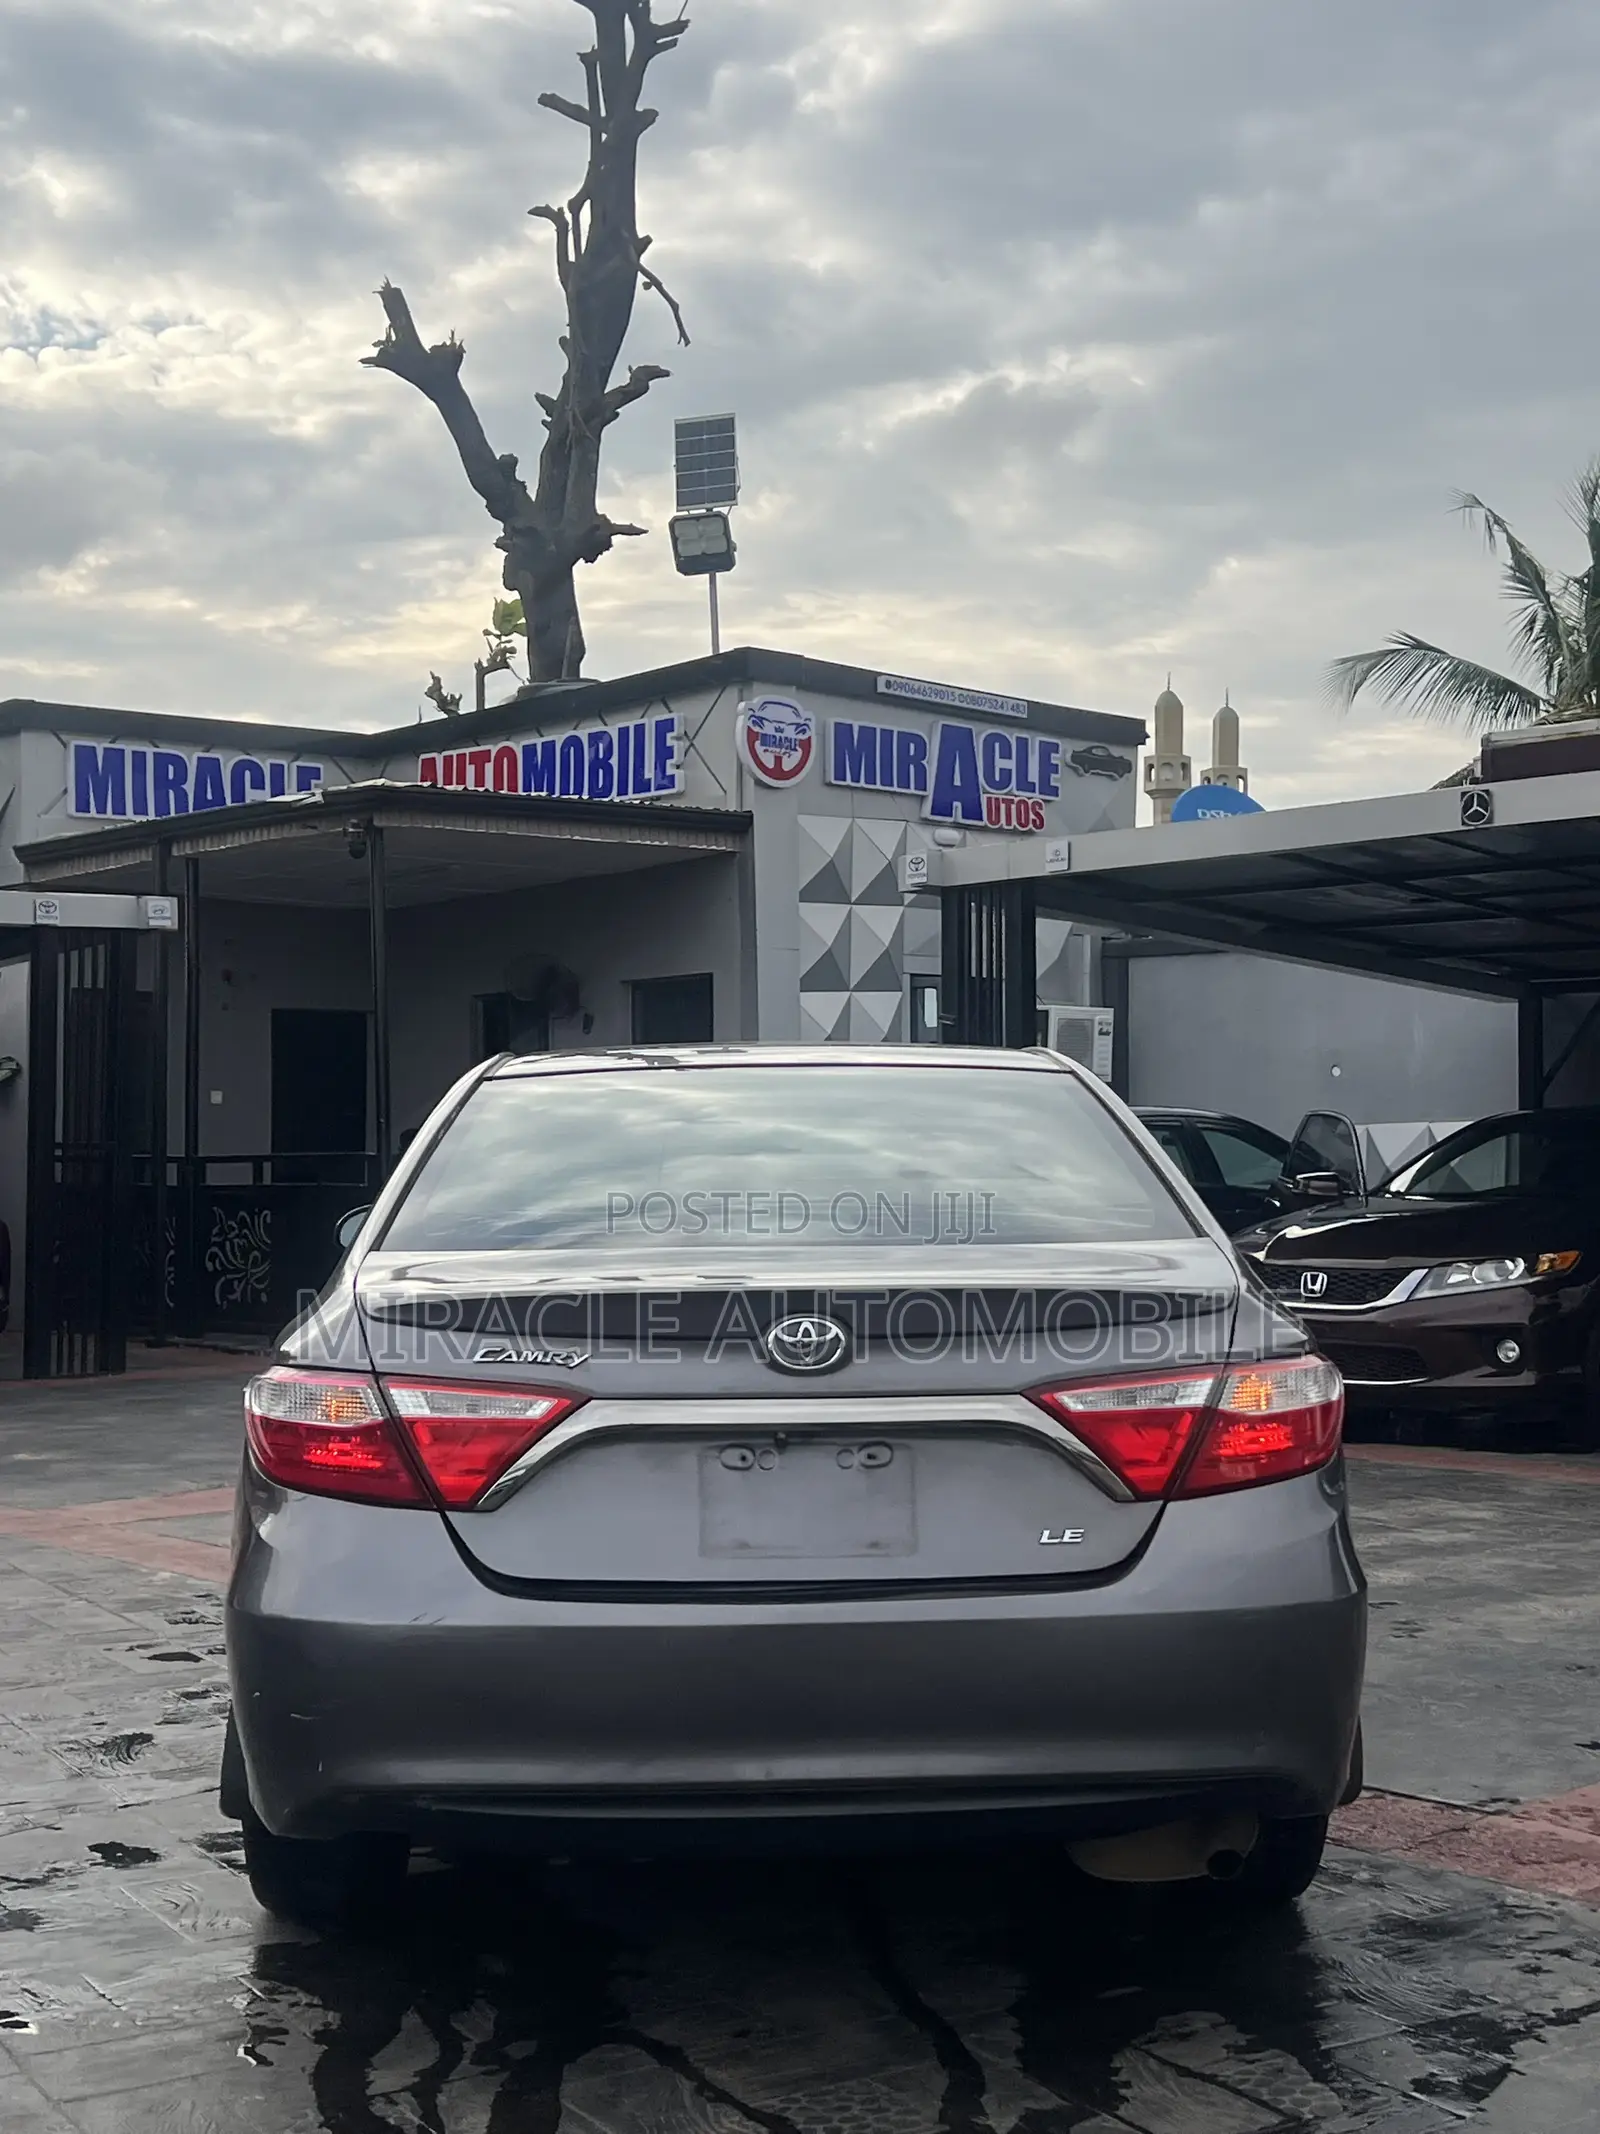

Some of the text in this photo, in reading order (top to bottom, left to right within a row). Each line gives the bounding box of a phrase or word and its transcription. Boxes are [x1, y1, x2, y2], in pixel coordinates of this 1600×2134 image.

[834, 723, 1061, 822] MIRACLE
[473, 1347, 592, 1369] CAMRY
[1039, 1528, 1085, 1545] LE
